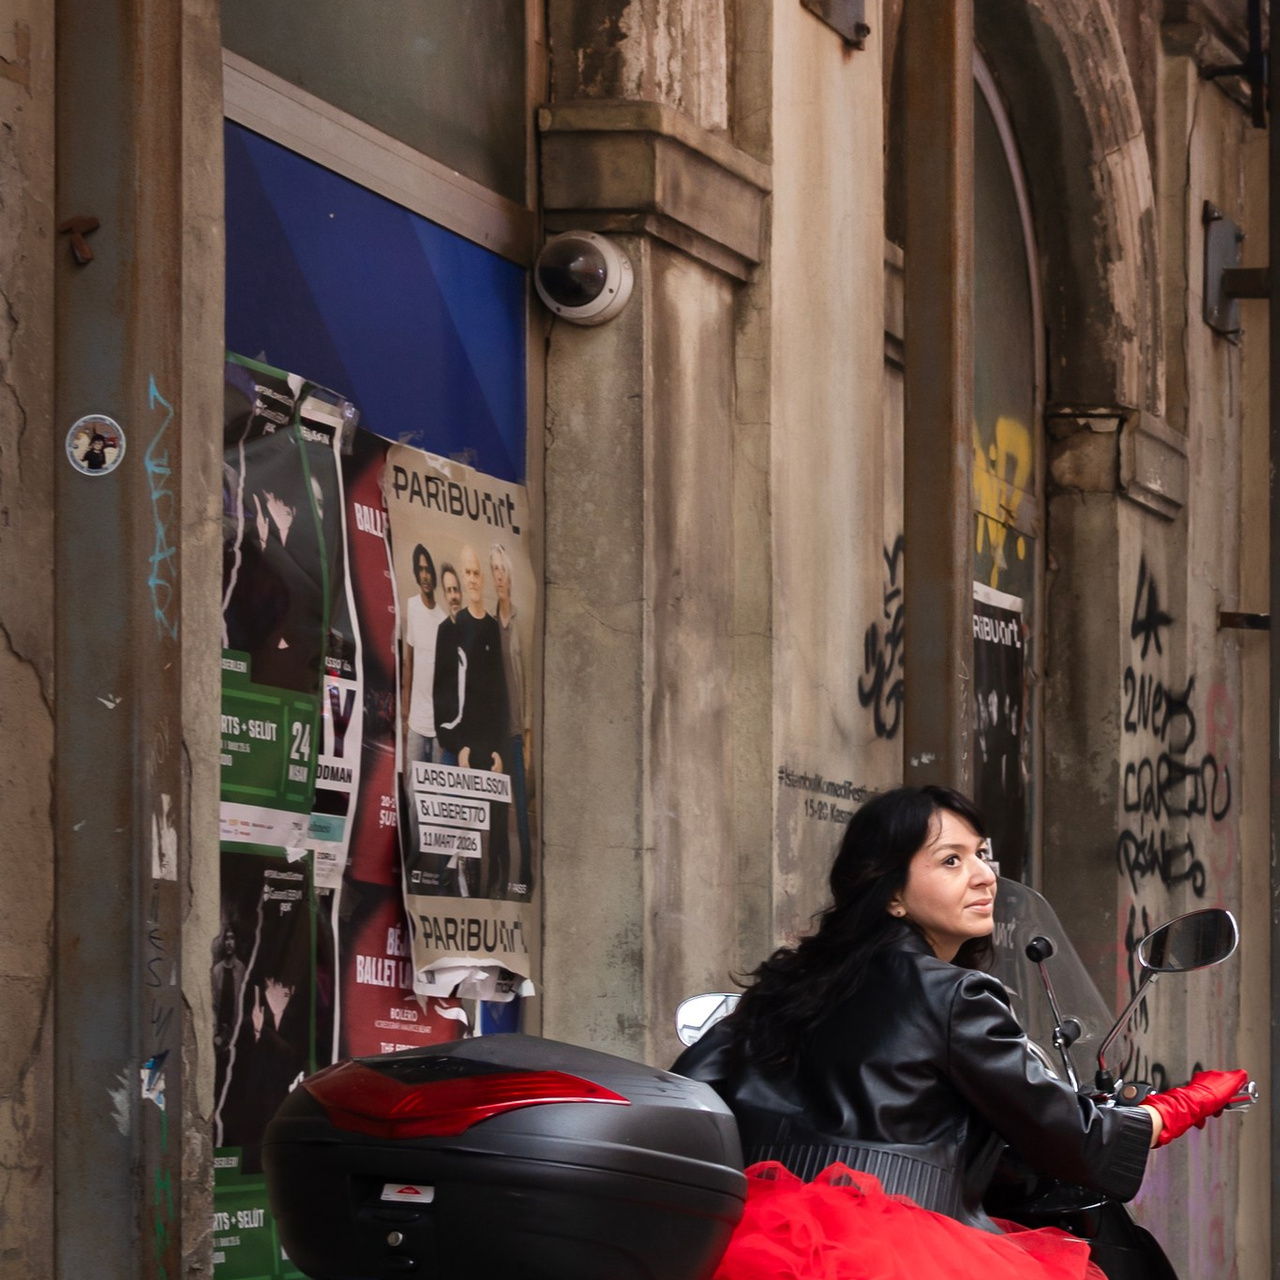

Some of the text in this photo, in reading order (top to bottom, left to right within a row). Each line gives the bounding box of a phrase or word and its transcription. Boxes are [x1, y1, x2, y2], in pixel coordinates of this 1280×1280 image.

[289, 721, 311, 762] 24
[415, 767, 510, 797] LARS DANIELSSON
[419, 799, 430, 817] &
[433, 832, 457, 850] MART
[456, 835, 478, 852] 2026
[355, 954, 397, 988] BALLET
